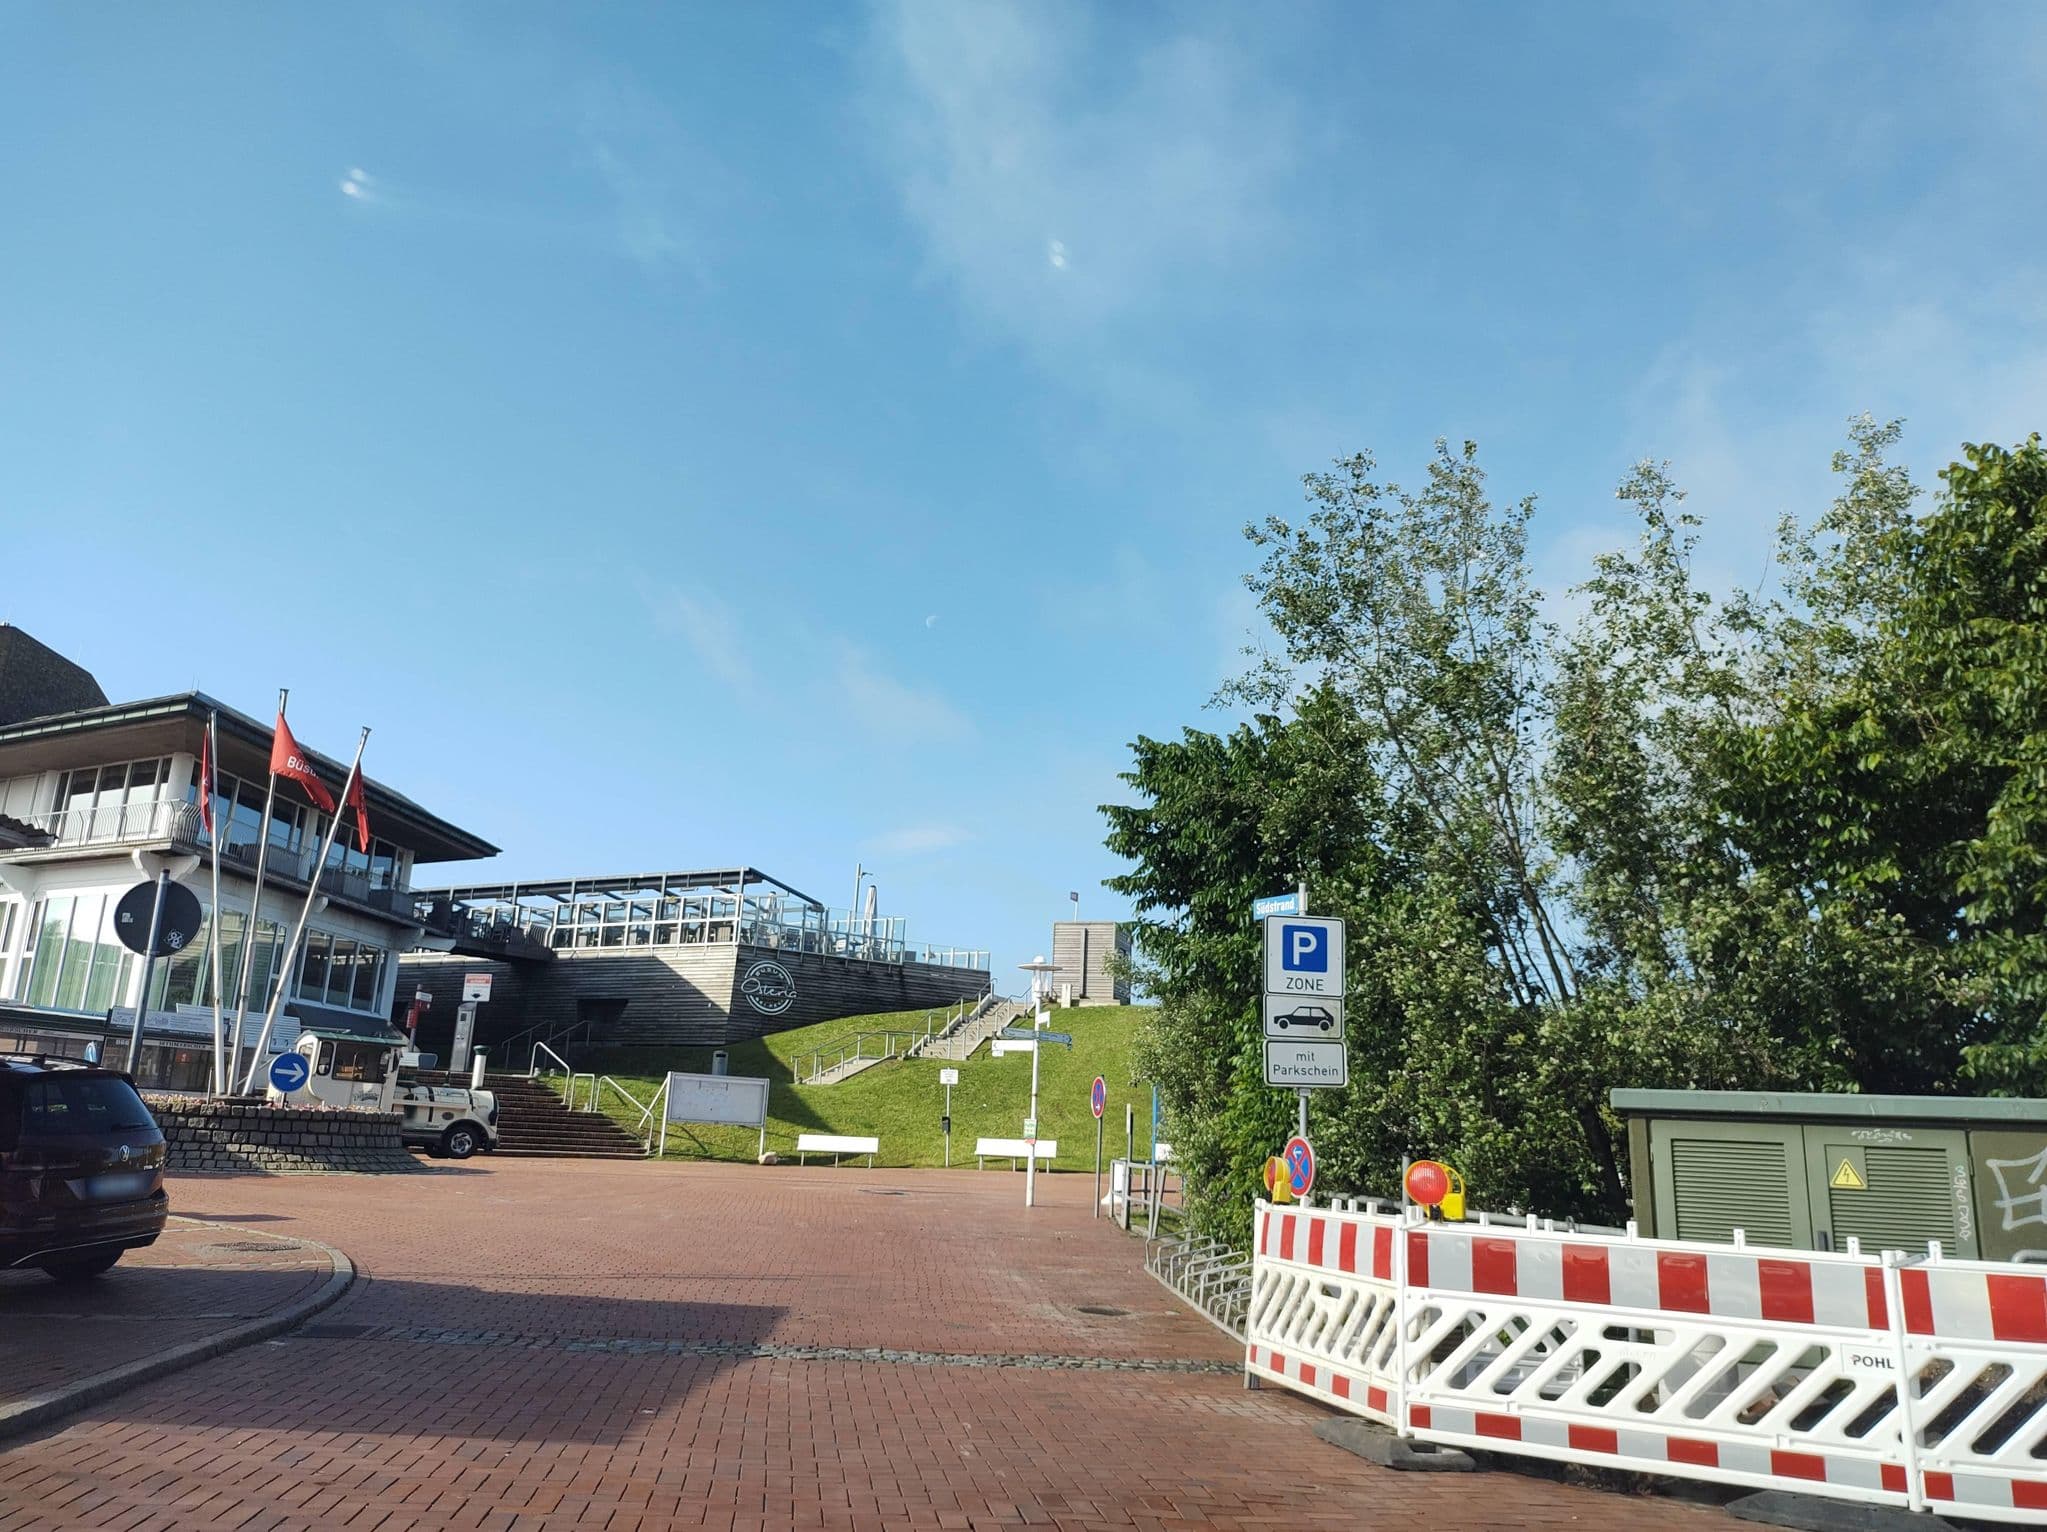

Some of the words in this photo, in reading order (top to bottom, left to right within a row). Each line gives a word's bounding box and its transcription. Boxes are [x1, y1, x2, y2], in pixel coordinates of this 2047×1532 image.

[1256, 897, 1295, 915] Südstrand
[1293, 931, 1317, 966] P
[1286, 976, 1324, 991] ZONE
[1296, 1051, 1315, 1061] mit
[1273, 1064, 1339, 1076] Parkschein
[1851, 1354, 1895, 1370] POHL
